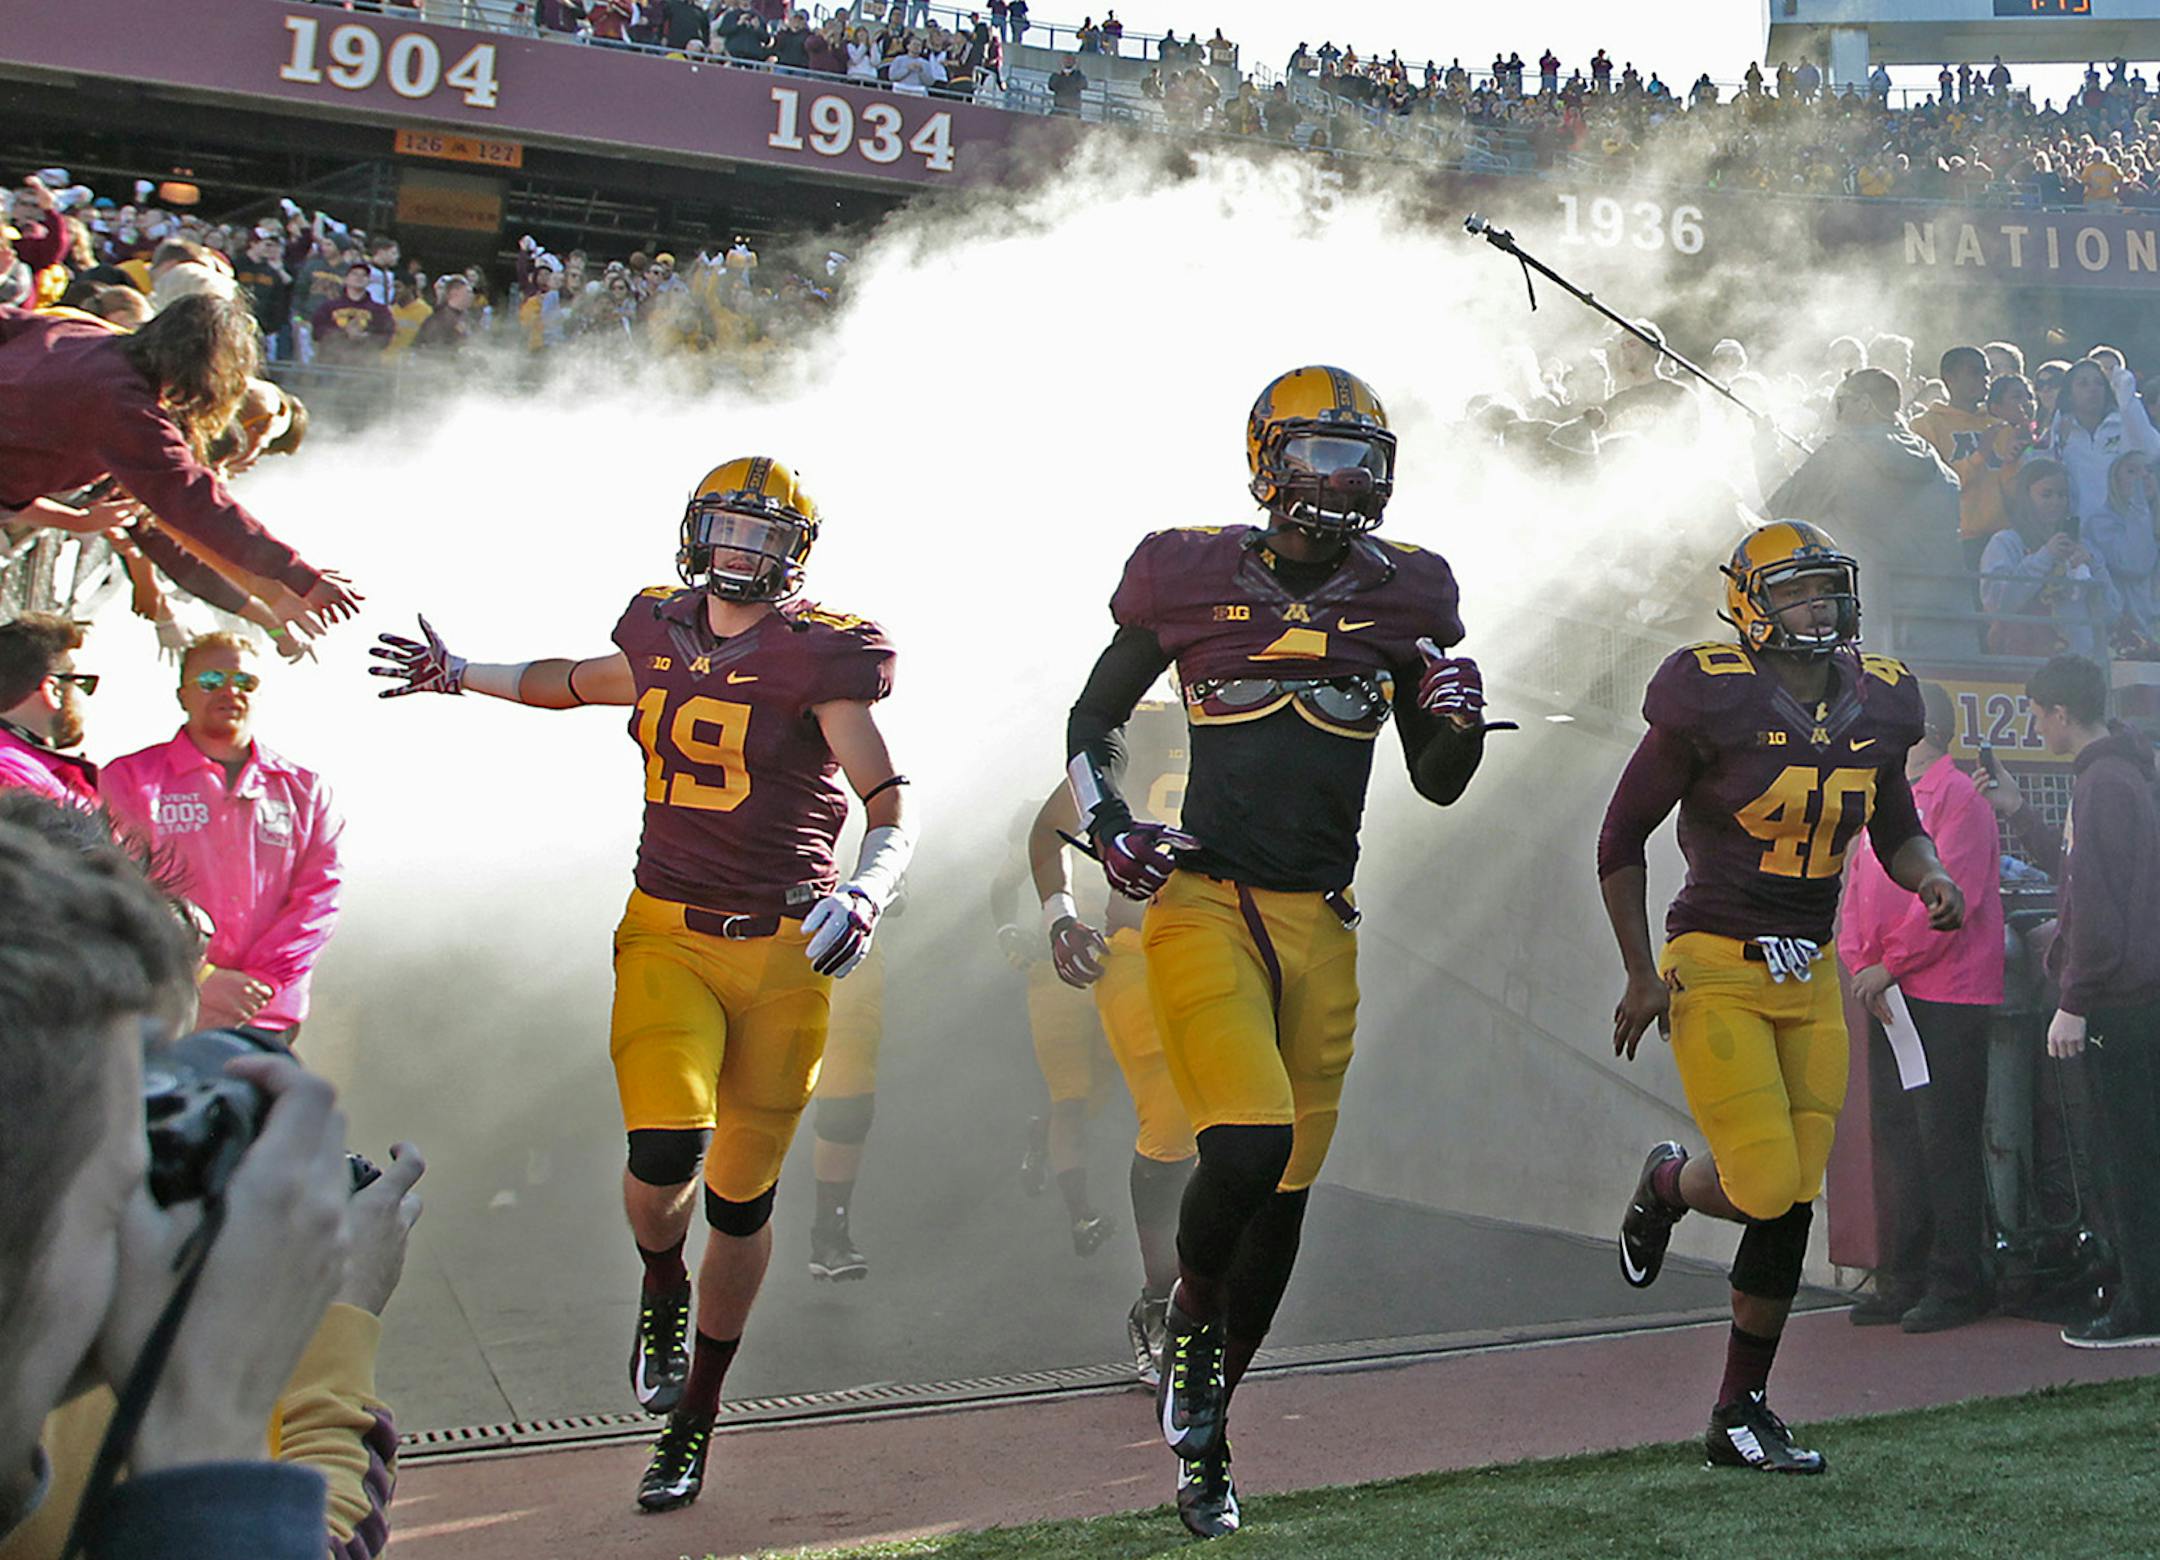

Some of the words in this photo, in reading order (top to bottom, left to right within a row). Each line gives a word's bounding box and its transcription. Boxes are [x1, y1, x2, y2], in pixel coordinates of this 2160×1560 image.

[280, 15, 498, 109] 1904
[405, 133, 443, 153] 126
[478, 144, 515, 162] 127
[768, 86, 956, 172] 1934
[1557, 193, 1706, 255] 1936
[1904, 221, 2158, 272] NATION
[636, 687, 752, 813] 19
[1959, 692, 2046, 750] 127
[1734, 765, 1877, 879] 40
